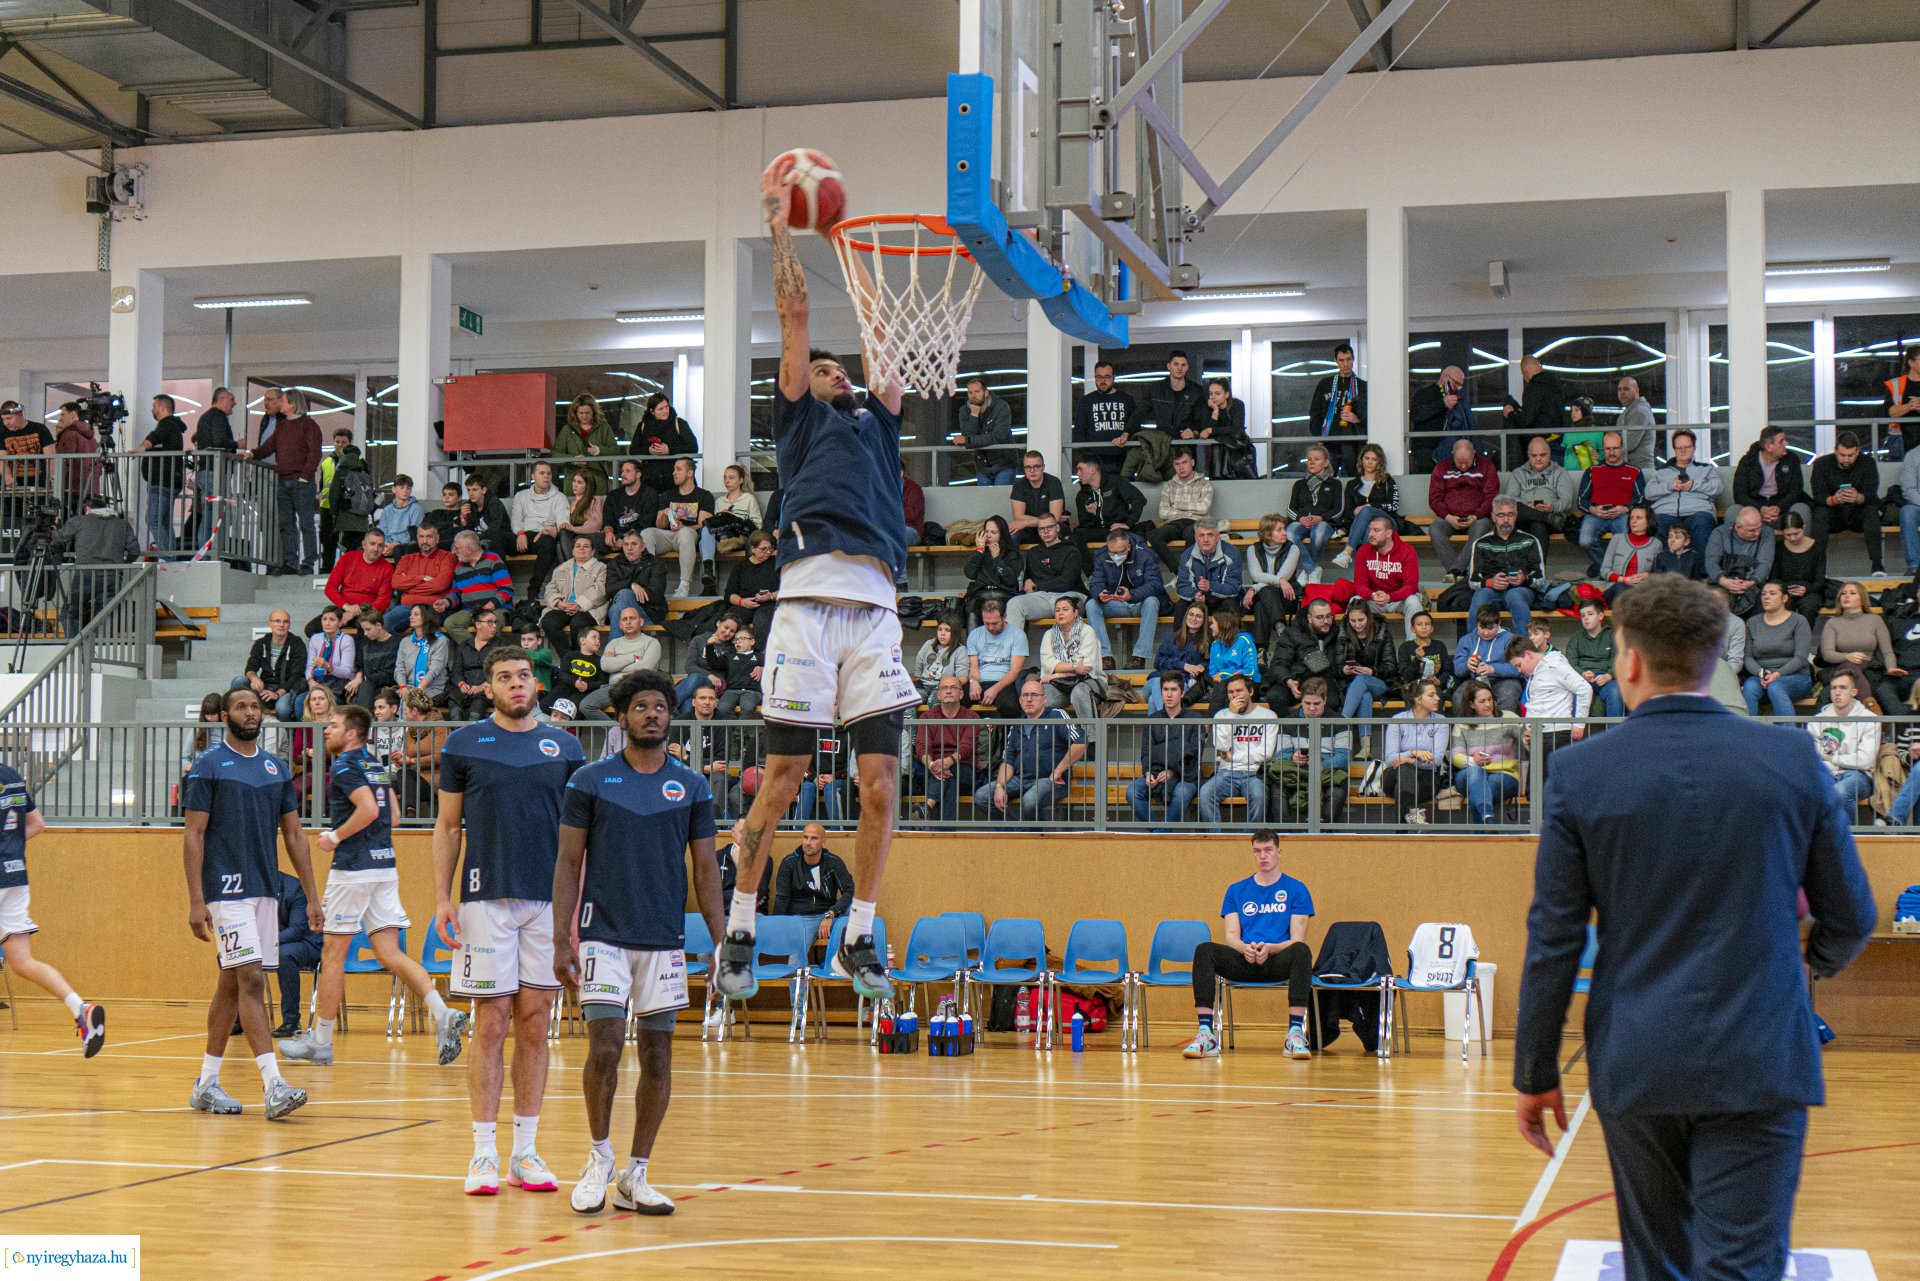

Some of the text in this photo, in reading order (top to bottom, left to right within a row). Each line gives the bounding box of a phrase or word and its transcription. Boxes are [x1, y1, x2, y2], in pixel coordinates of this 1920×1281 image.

[1093, 402, 1125, 412] NEVER
[1093, 411, 1125, 421] STOP
[1095, 421, 1125, 431] SMILING
[791, 521, 805, 550] 1
[896, 689, 913, 699] JAKO
[221, 873, 244, 894] 22
[469, 868, 480, 893] 8
[581, 902, 594, 928] 0
[1259, 903, 1287, 914] JAKO
[220, 931, 242, 953] 22
[1438, 927, 1456, 959] 8
[464, 954, 471, 978] 8
[584, 958, 596, 982] 0
